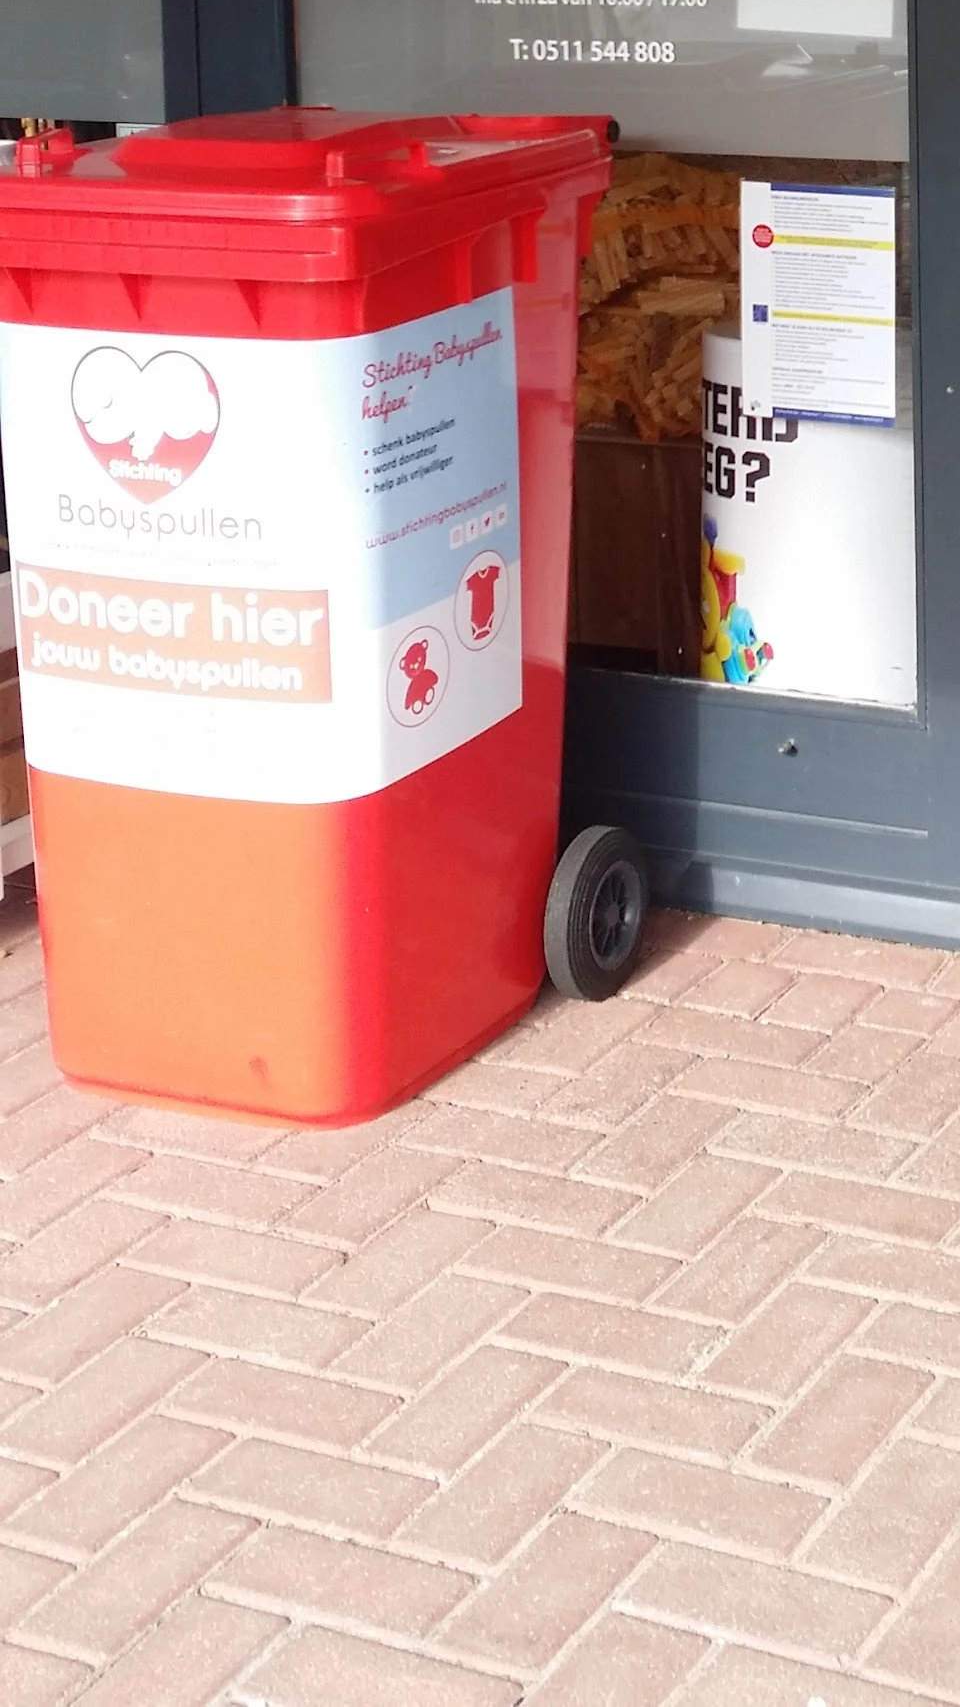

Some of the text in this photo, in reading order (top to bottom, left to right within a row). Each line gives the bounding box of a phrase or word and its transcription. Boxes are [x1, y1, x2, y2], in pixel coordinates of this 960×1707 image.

[509, 38, 676, 63] T: 0511 544 808
[362, 321, 503, 388] Stichting Babyspullen
[372, 418, 455, 457] schenk babyspullen
[109, 459, 182, 487] Stichting
[373, 444, 438, 475] word donateur
[374, 455, 455, 494] help als vrijwilliger
[58, 493, 263, 542] Babyspullen
[18, 568, 325, 648] Doneer hier
[30, 631, 304, 692] jouw babyspullen
